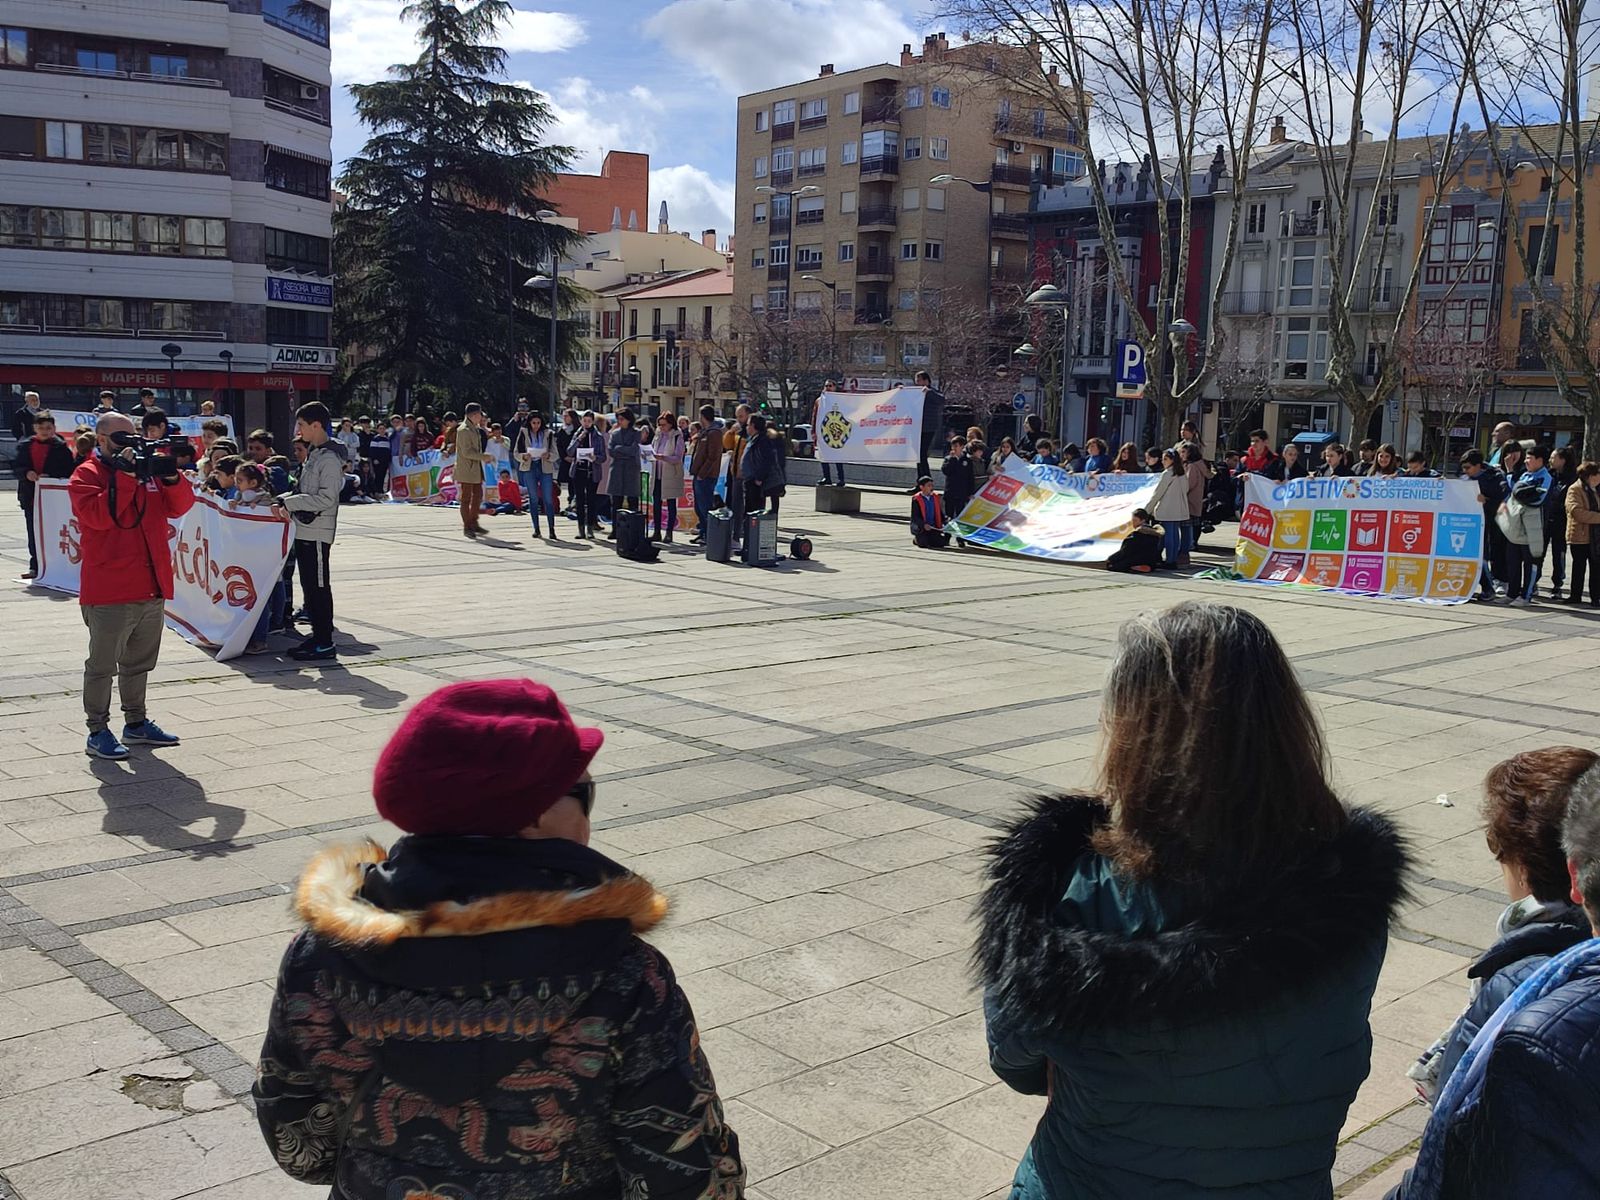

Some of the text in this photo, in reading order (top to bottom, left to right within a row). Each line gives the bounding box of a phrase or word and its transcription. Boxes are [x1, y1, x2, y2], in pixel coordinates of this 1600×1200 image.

[276, 348, 320, 363] ADINCO
[1123, 344, 1141, 379] P
[101, 372, 166, 384] MAPFRE
[263, 376, 290, 386] MAPFR
[1386, 480, 1444, 488] DESARROLLO
[1272, 479, 1372, 501] OBJETIVOS
[1373, 488, 1443, 500] SOSTENIBLE
[1353, 513, 1359, 522] 4
[1348, 558, 1356, 567] 10
[1436, 562, 1445, 572] 12
